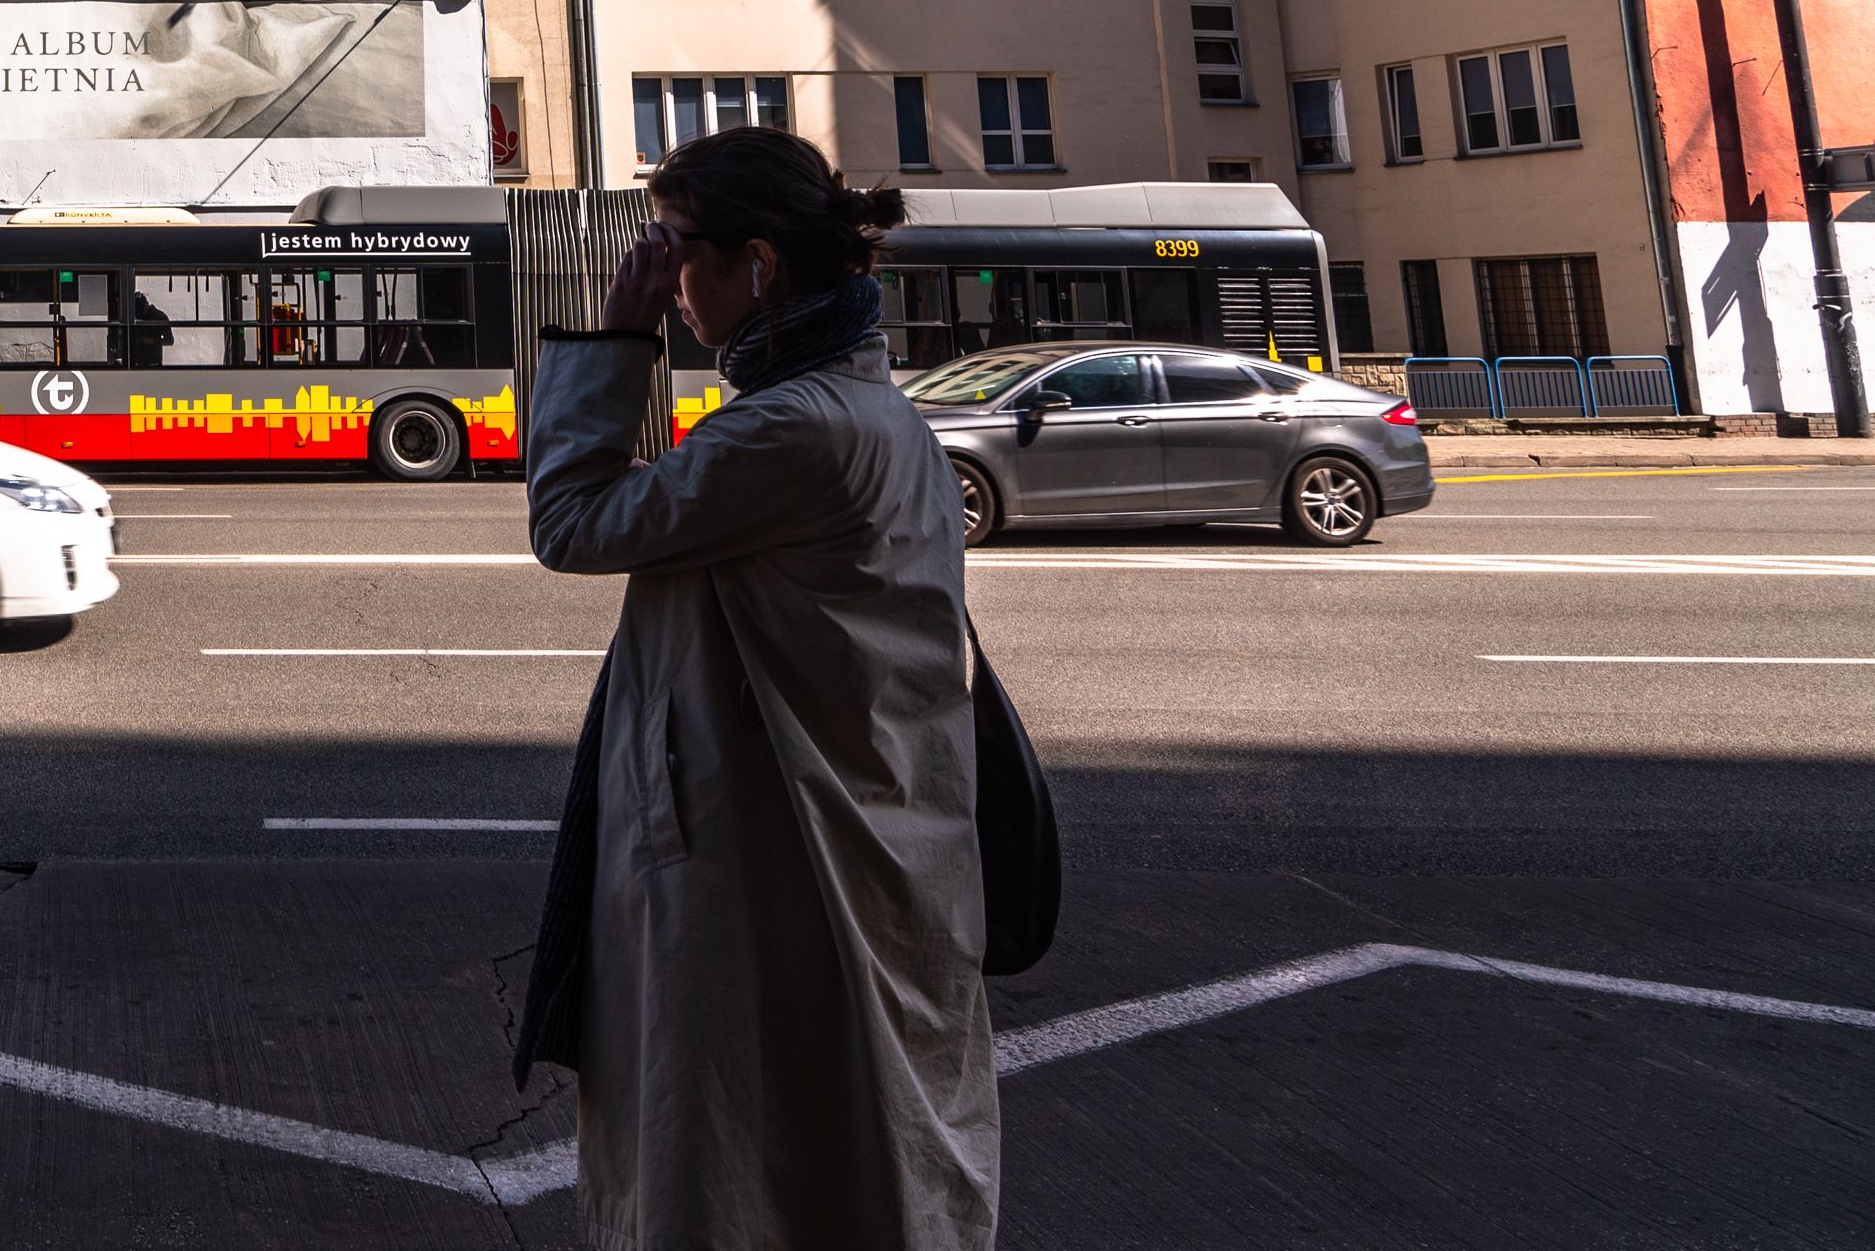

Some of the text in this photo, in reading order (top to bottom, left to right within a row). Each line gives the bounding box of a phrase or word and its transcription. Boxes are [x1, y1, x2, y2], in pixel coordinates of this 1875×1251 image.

[10, 30, 153, 57] ALBUM
[270, 232, 471, 252] jestem hybrydowy
[1155, 239, 1200, 257] 8399
